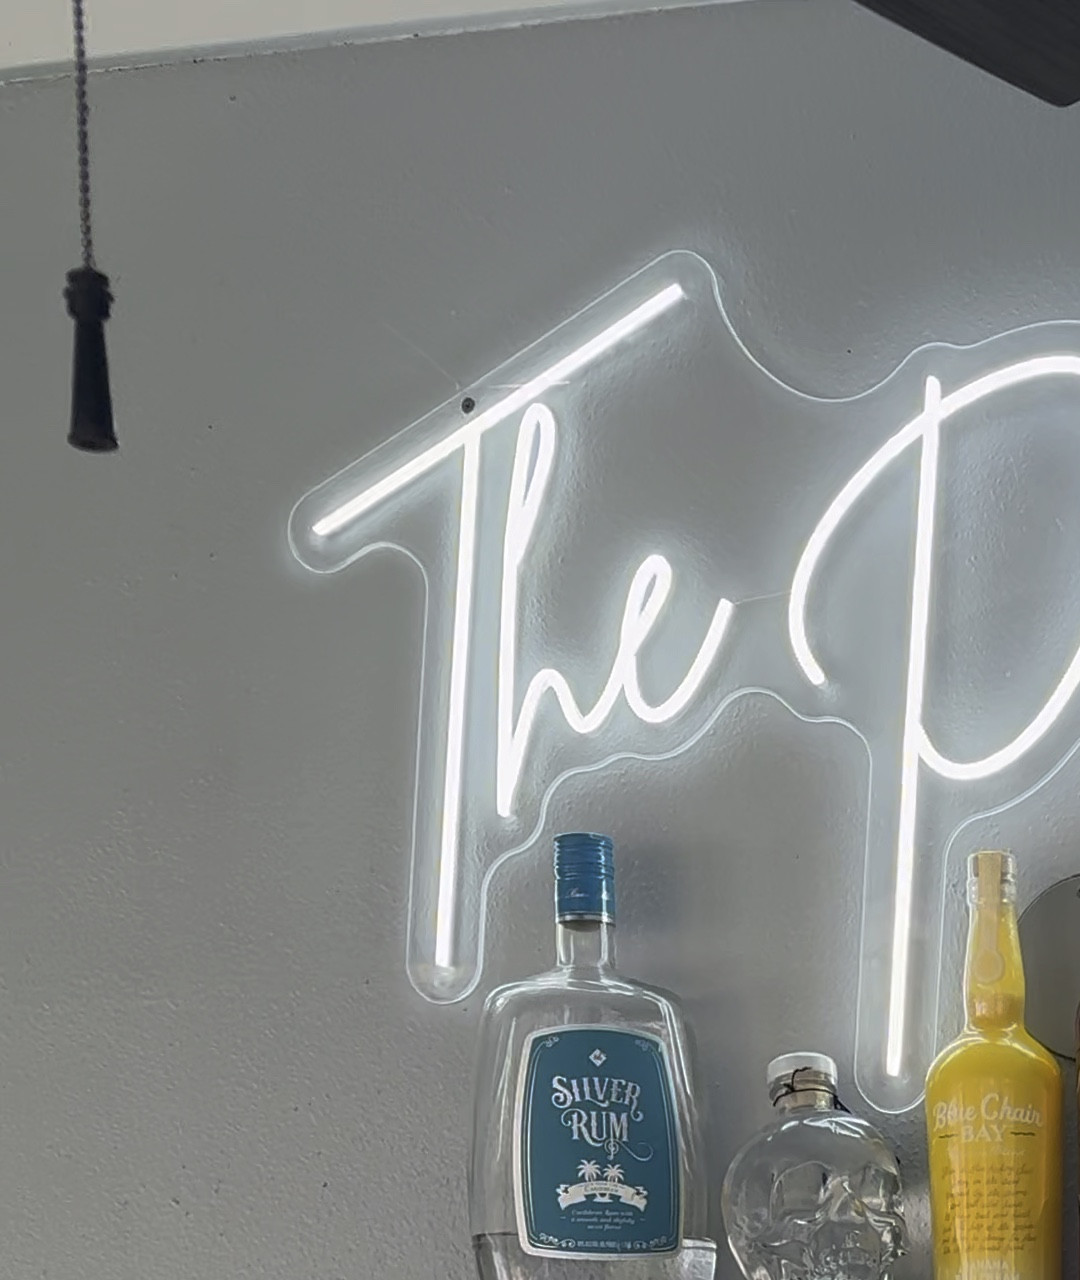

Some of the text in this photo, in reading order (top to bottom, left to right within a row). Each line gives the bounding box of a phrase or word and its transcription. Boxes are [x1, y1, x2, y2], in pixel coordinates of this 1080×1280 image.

[312, 282, 735, 968] The
[551, 1075, 644, 1122] SILVER
[981, 1092, 1044, 1128] Chair
[561, 1108, 641, 1152] RUM
[961, 1123, 1008, 1143] BAY
